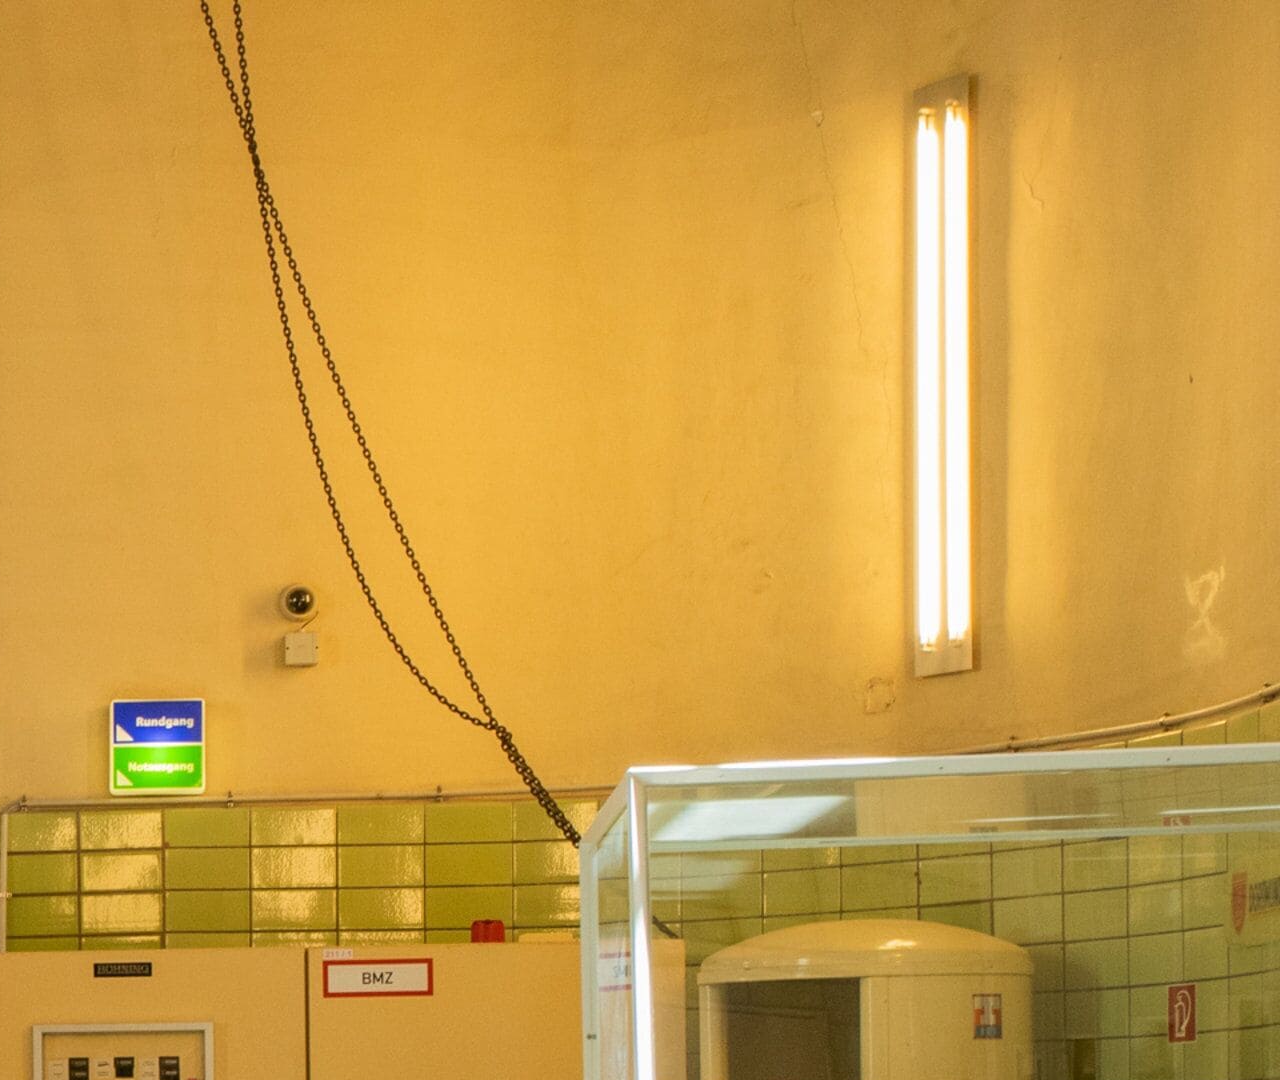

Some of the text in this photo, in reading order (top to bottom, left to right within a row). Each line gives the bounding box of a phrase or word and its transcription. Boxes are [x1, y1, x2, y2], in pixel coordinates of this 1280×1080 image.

[135, 716, 195, 729] Rundgang
[127, 762, 195, 773] Notausgang
[361, 972, 393, 984] BMZ
